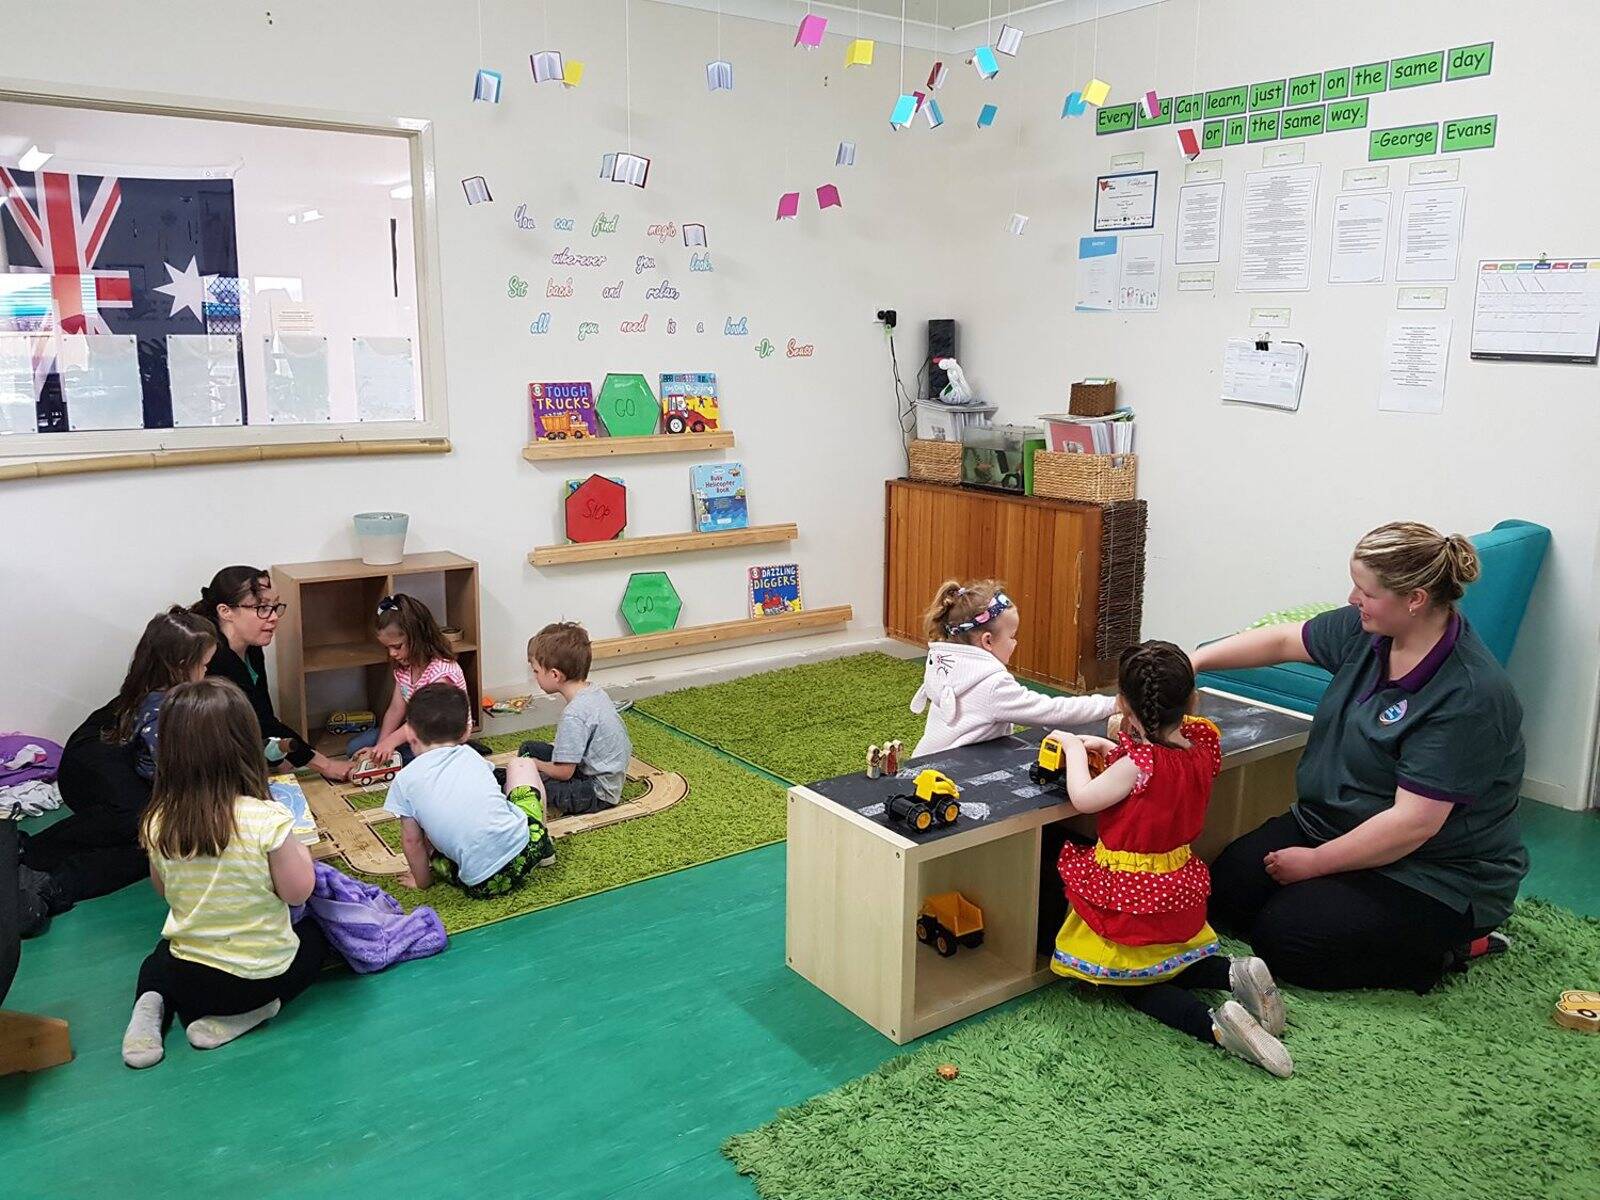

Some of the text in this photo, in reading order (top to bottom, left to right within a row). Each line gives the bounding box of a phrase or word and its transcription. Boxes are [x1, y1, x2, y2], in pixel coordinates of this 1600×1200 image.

[1098, 110, 1133, 126] Every
[1177, 99, 1199, 113] Can
[1207, 93, 1244, 109] learn,
[1251, 85, 1282, 107] just
[1292, 80, 1316, 96] not
[1327, 76, 1345, 90] on
[1355, 69, 1382, 86] the
[1394, 61, 1438, 79] same
[1453, 50, 1485, 71] day
[1206, 107, 1364, 140] or in the same way.
[1374, 122, 1491, 148] -George Evans
[514, 203, 676, 244] You can find magic
[551, 246, 607, 267] wherever
[636, 254, 655, 275] you
[507, 275, 680, 300] Sit back and relax,
[529, 312, 550, 335] all
[577, 321, 600, 341] you
[620, 313, 649, 333] need
[666, 317, 677, 334] is
[696, 321, 704, 333] a
[786, 337, 814, 358] Seuss
[545, 385, 589, 398] TOUGH
[536, 397, 591, 411] TRUCKS
[614, 398, 636, 418] GO
[753, 575, 798, 590] DIGGERS
[762, 566, 797, 578] DAZZLING
[636, 595, 654, 614] GO
